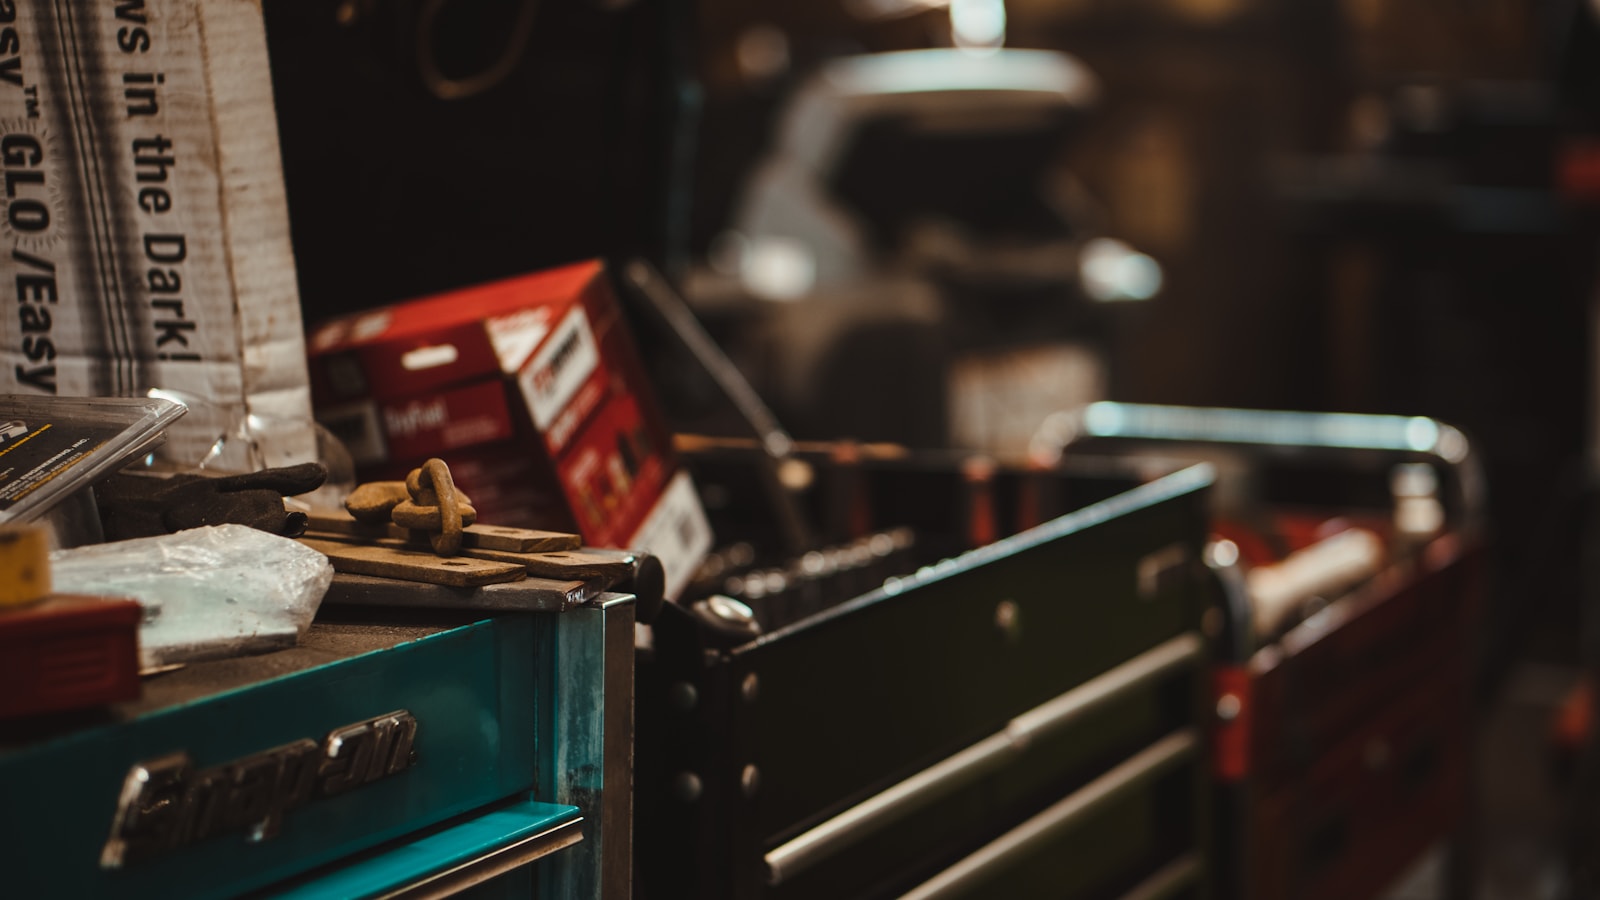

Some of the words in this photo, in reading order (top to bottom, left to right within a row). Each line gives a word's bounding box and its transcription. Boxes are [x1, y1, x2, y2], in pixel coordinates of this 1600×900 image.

[122, 72, 165, 118] in
[1, 133, 51, 232] GLO
[131, 134, 176, 215] the
[143, 233, 202, 362] Dark!
